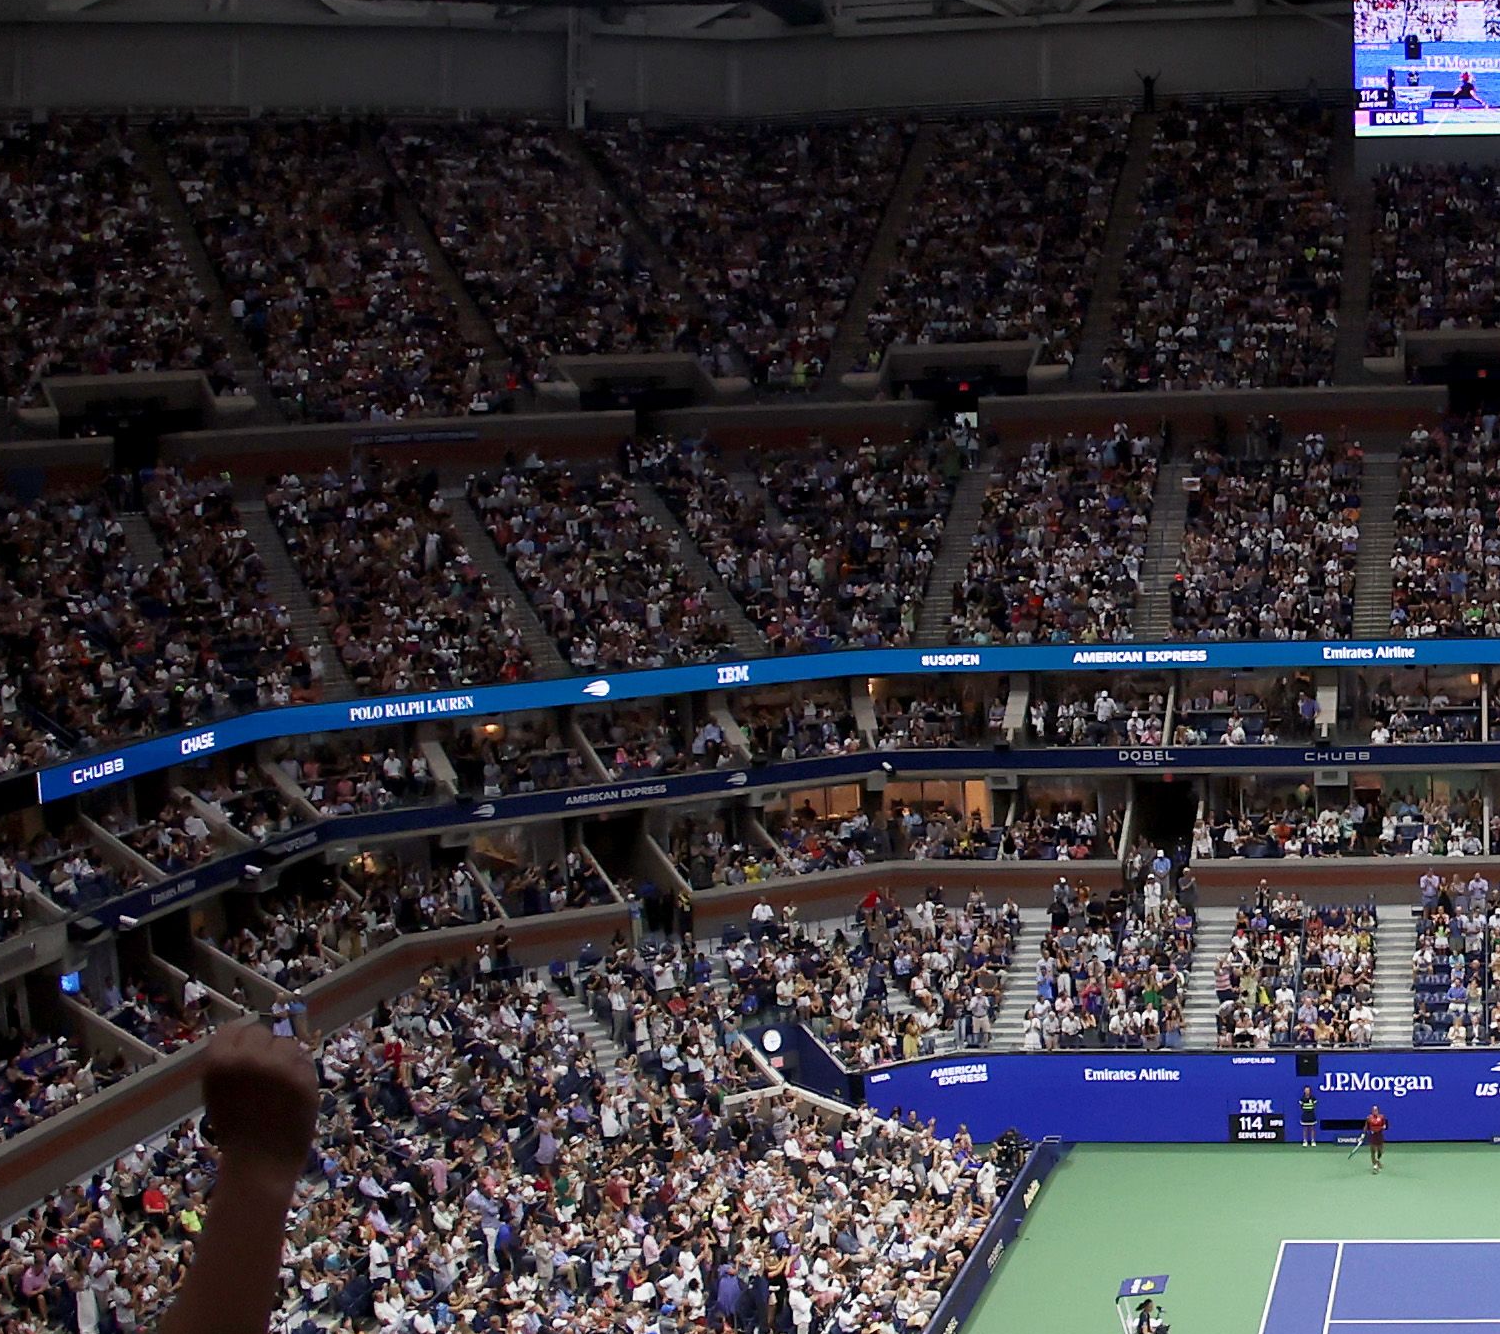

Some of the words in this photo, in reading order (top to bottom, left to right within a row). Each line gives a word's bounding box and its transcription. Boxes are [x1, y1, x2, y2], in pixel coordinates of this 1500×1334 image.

[1360, 90, 1379, 101] 114
[1375, 112, 1417, 124] DEUCE
[1073, 651, 1143, 664] AMERICAN
[1145, 650, 1207, 663] EXPRESS
[1323, 646, 1373, 660] Emirates
[1375, 646, 1415, 659] Airline
[717, 665, 750, 684] IBM
[350, 705, 383, 722] POLO
[385, 700, 425, 718] RALPH
[427, 695, 474, 713] LAUREN
[180, 731, 215, 755] CHASE
[1118, 750, 1174, 761] DOBEL
[1304, 751, 1370, 761] CHUBB
[72, 757, 125, 785] CHUBB
[565, 788, 620, 805] AMERICAN
[621, 784, 667, 799] EXPRESS
[930, 1064, 987, 1079] AMERICAN
[1084, 1069, 1137, 1081] Emirates
[1139, 1068, 1180, 1081] Airline
[938, 1072, 988, 1086] EXPRESS
[1319, 1072, 1433, 1097] J.P.Morgan
[1240, 1099, 1273, 1114] IBM
[1239, 1116, 1263, 1130] 114
